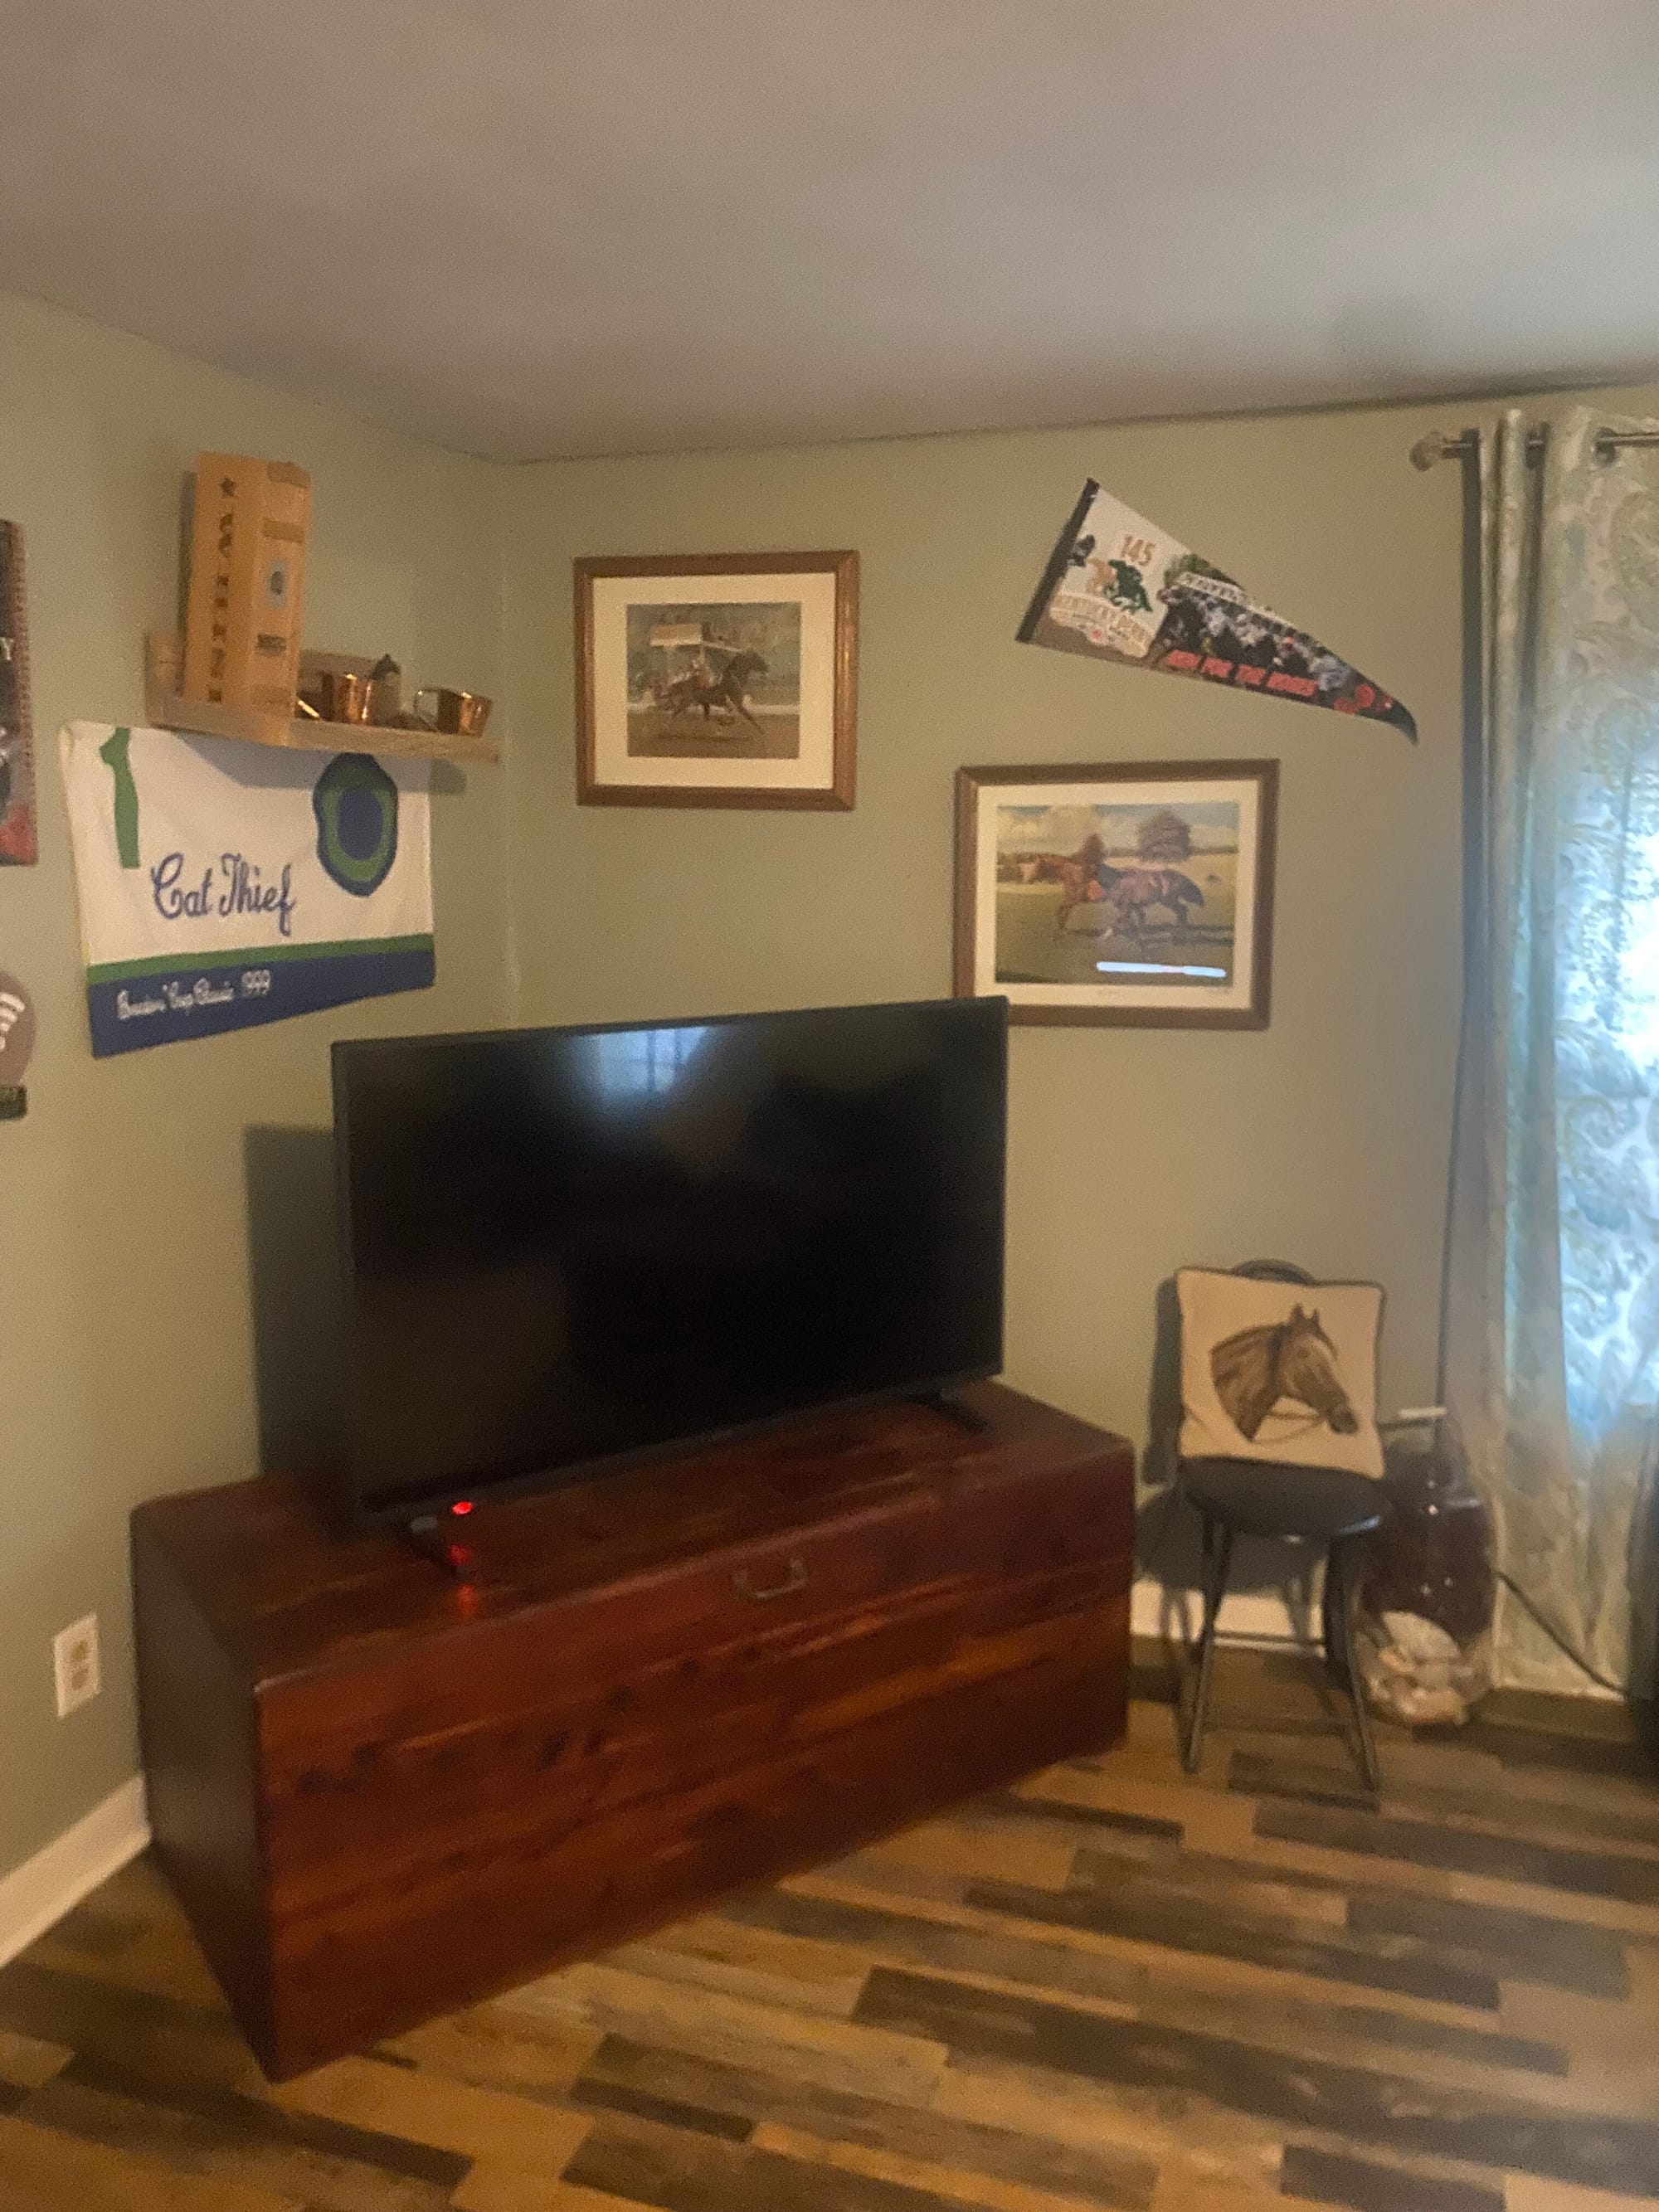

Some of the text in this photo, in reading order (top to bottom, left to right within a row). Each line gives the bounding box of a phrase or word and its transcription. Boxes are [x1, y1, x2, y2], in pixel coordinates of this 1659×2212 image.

[1121, 534, 1156, 566] 145
[150, 852, 297, 937] Cat Thief
